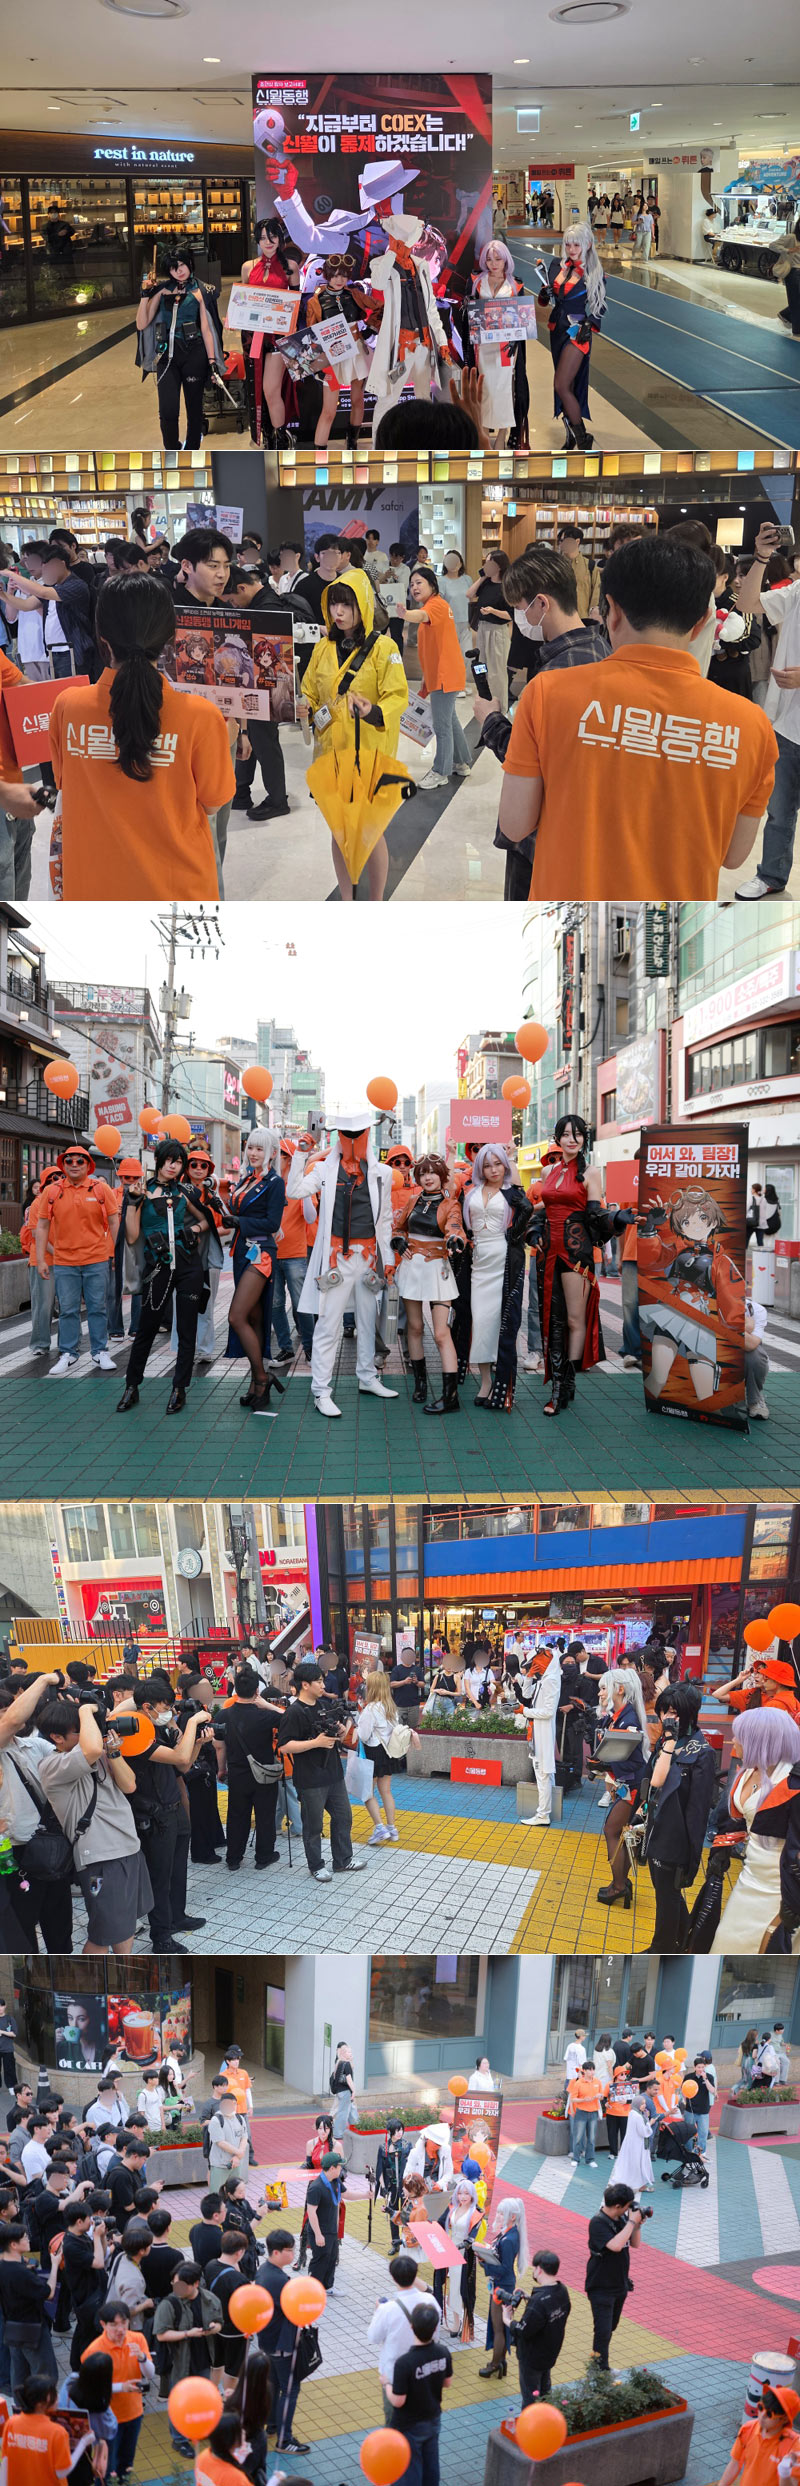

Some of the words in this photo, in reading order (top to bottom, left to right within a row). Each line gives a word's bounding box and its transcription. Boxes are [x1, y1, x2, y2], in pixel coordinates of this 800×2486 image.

[256, 89, 309, 105] 신월동행
[298, 114, 376, 133] “지금부터
[381, 114, 443, 132] COEX는
[282, 135, 336, 153] 신월이
[340, 134, 474, 153] 통제하겠습니다!”
[94, 147, 128, 160] rest
[131, 145, 147, 160] in
[149, 149, 195, 162] nature
[303, 488, 385, 511] AMY
[381, 501, 404, 511] safari
[213, 618, 252, 630] 미니게임
[578, 700, 740, 770] 신월동행
[67, 723, 178, 767] 신월행
[97, 989, 135, 1002] 부동산
[105, 1113, 124, 1124] TACO
[462, 1115, 500, 1128] 신월동행
[650, 1147, 676, 1160] 어서
[679, 1146, 696, 1161] 와,
[702, 1146, 736, 1160] 팀장!
[645, 1164, 671, 1177] 우리
[675, 1164, 702, 1178] 같이
[705, 1164, 740, 1178] 가자!
[279, 1557, 307, 1565] NORAEBAN
[607, 1955, 614, 1966] 2
[605, 1977, 611, 1987] 1
